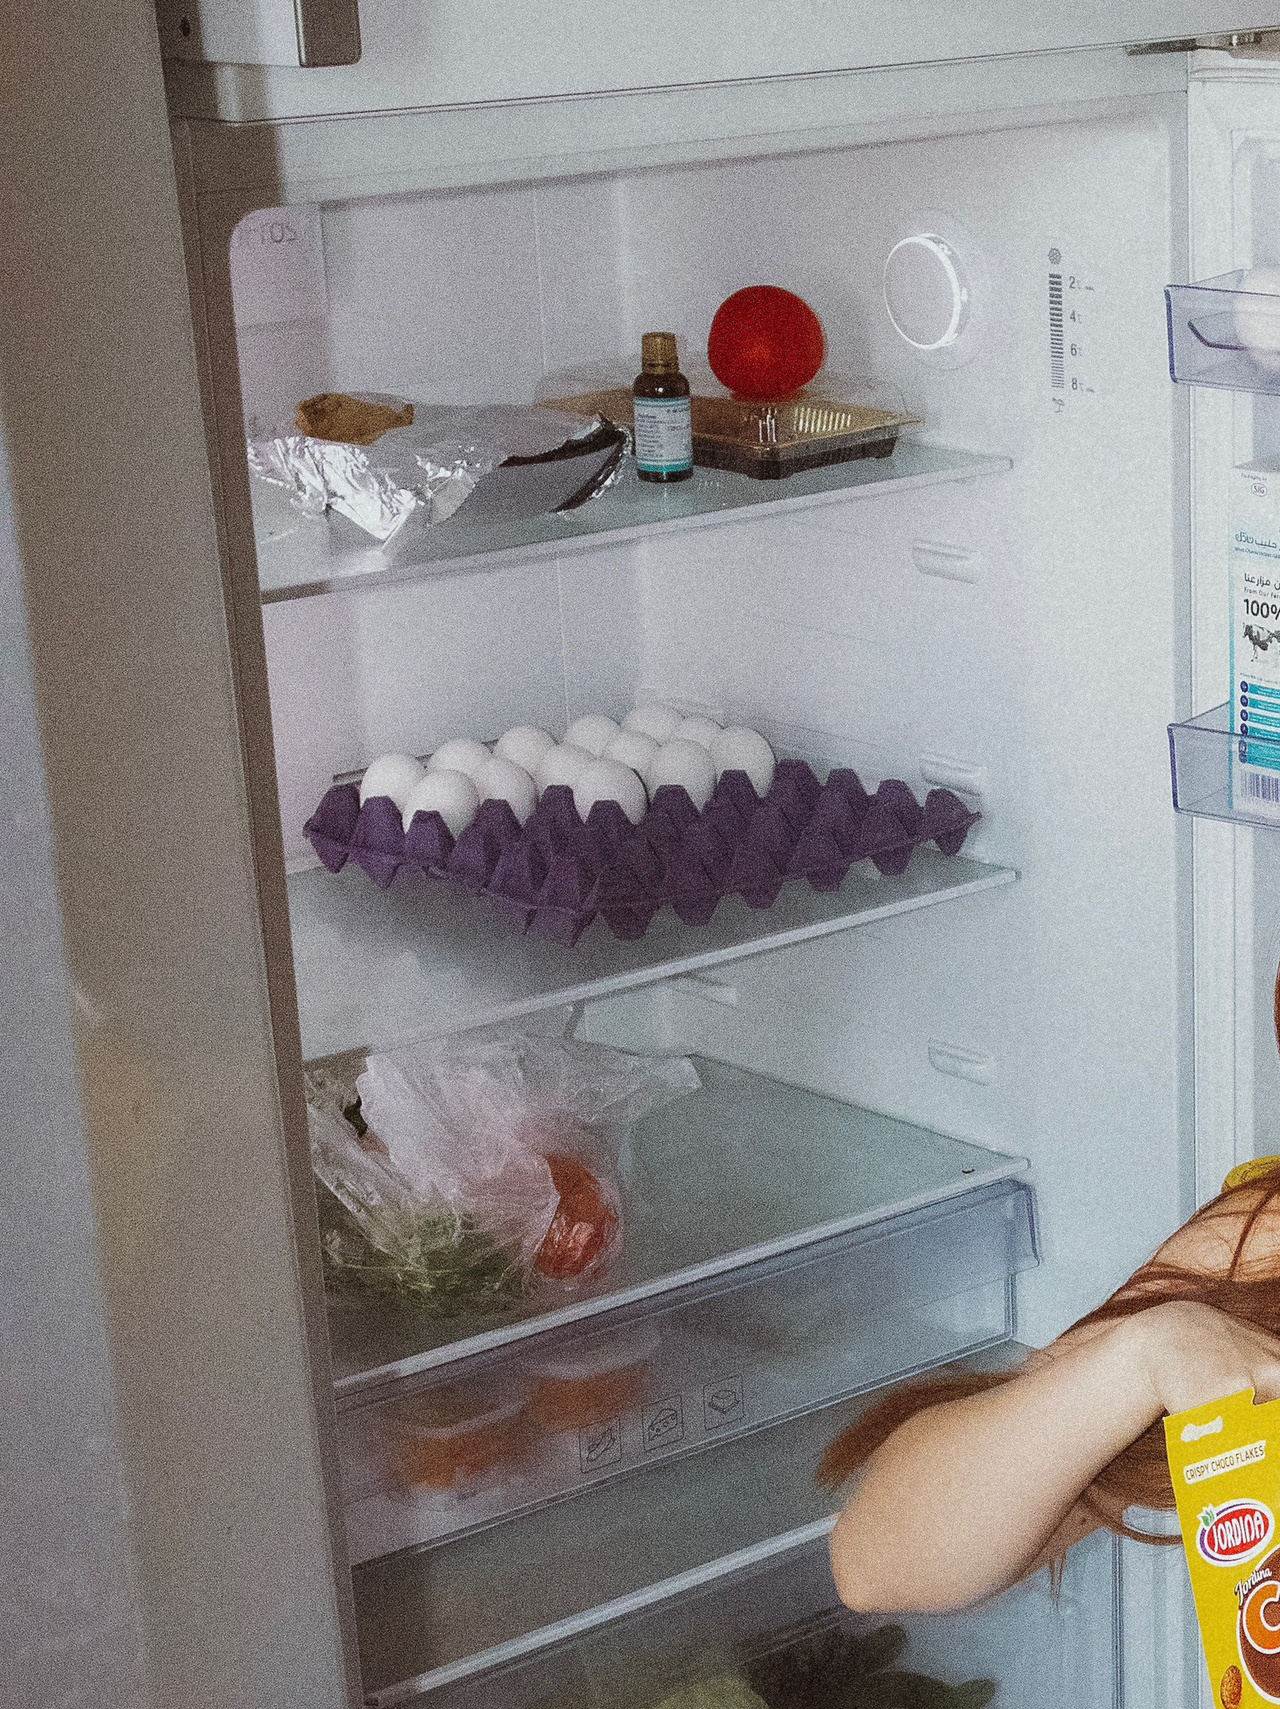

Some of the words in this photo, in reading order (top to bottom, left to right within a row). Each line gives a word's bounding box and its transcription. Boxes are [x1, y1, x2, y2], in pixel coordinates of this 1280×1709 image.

[1253, 486, 1265, 494] SIG
[1244, 572, 1271, 588] مزارعنا
[1185, 1463, 1209, 1481] CRISPY
[1210, 1454, 1235, 1473] CHOCO
[1235, 1445, 1265, 1465] FLAKES
[1212, 1510, 1265, 1553] JORDINA
[1234, 1567, 1272, 1606] Jordina
